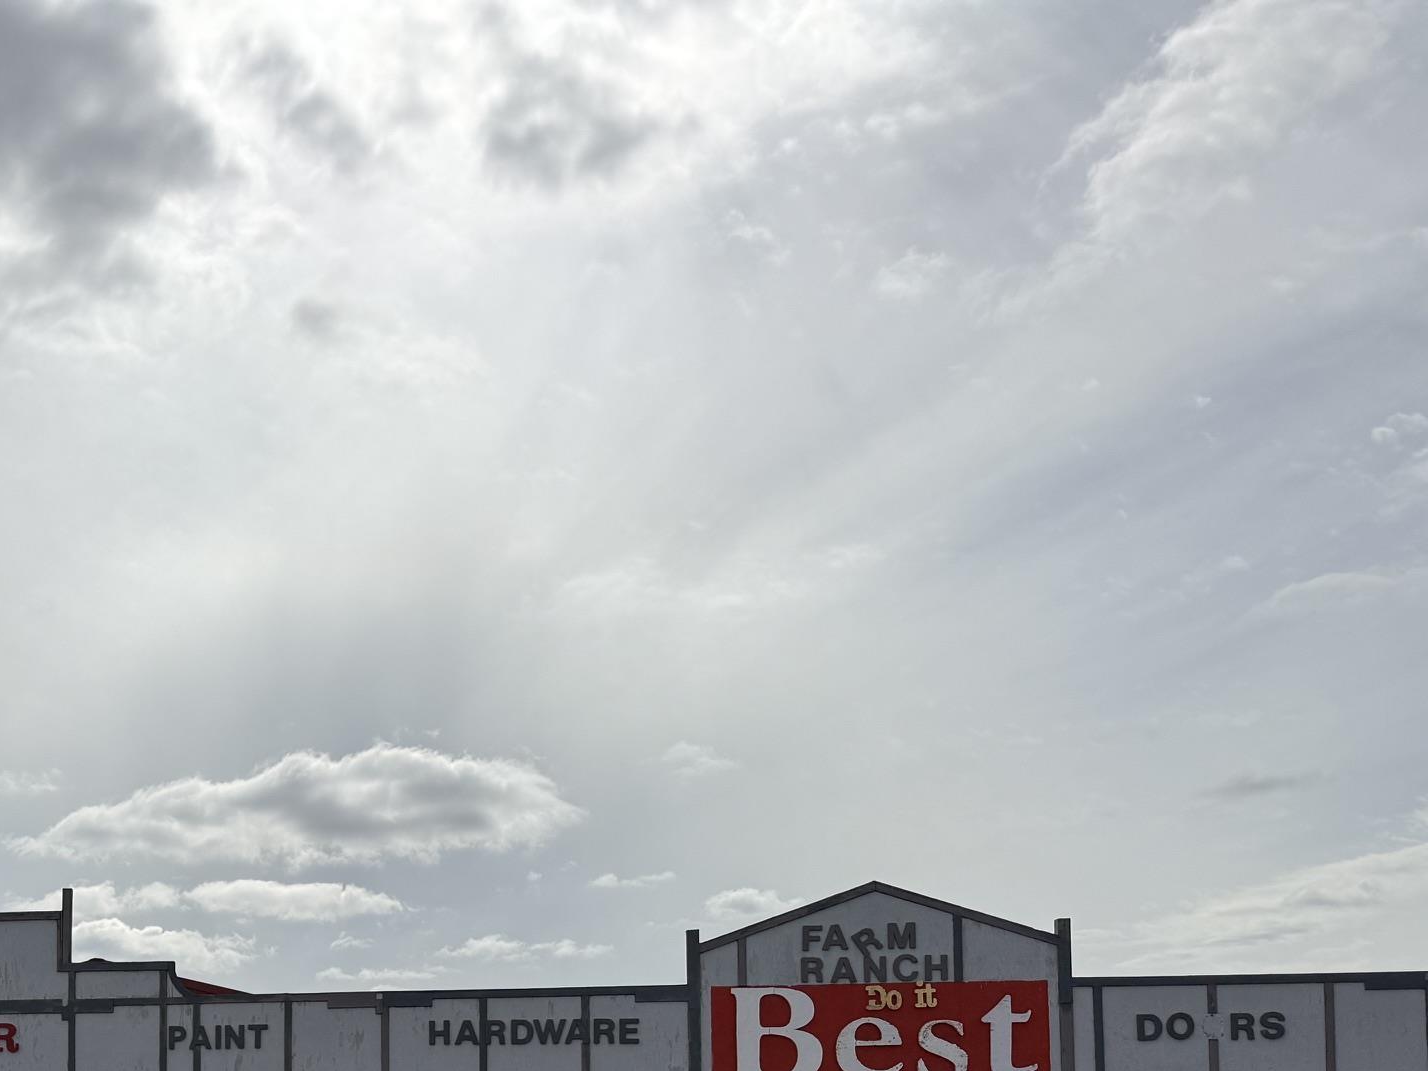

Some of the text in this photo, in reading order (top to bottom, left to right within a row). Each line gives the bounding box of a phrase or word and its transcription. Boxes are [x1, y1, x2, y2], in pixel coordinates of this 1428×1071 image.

[801, 922, 916, 956] FARM
[800, 954, 949, 984] RANCH
[865, 981, 938, 1011] Do it
[167, 1024, 269, 1050] PAINT
[428, 1018, 641, 1046] HARDWARE
[1135, 1011, 1286, 1042] DORS
